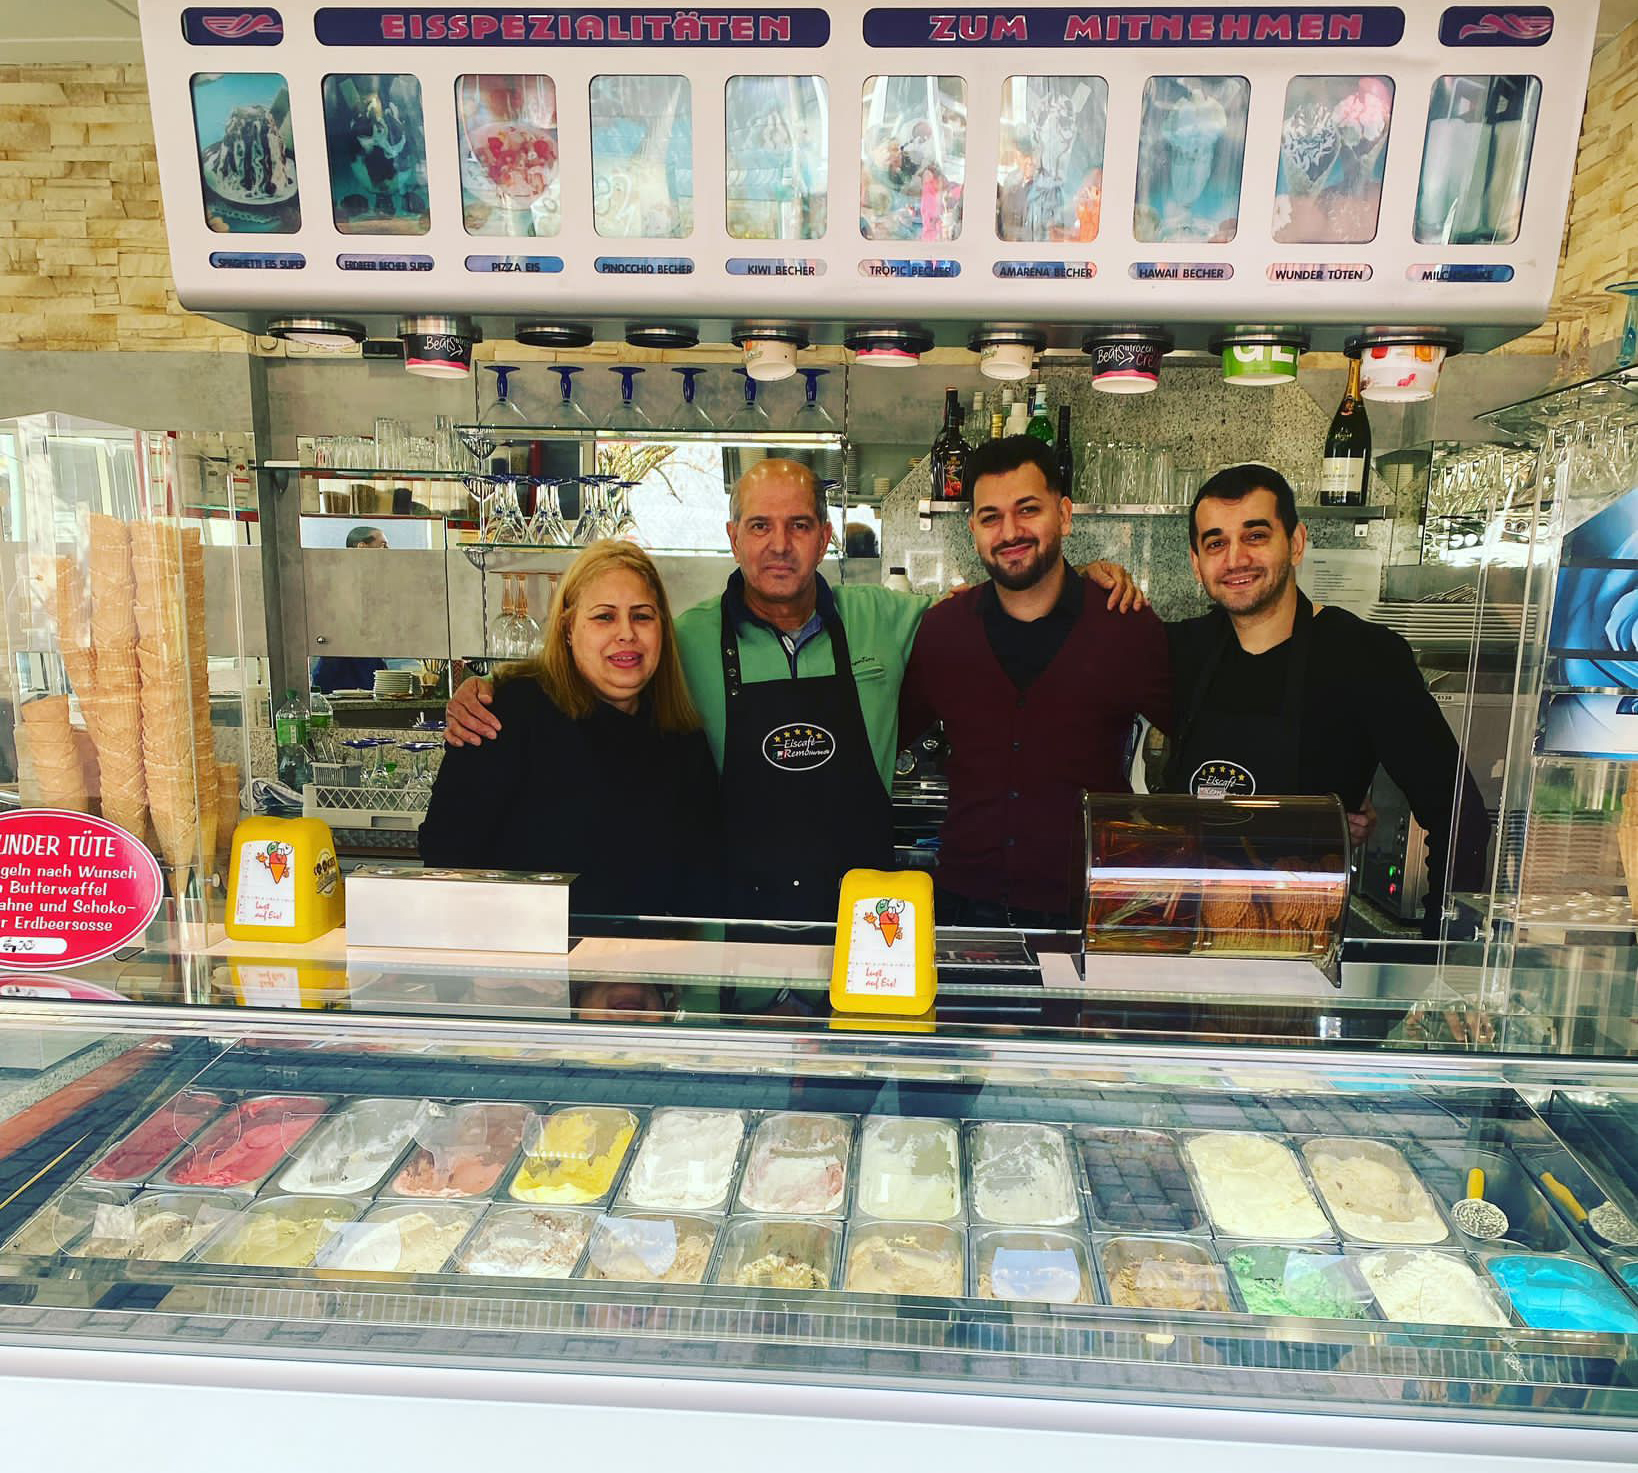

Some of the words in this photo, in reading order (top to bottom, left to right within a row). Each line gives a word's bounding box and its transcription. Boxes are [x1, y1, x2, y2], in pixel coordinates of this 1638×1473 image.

[381, 11, 791, 41] EISSPEZIALITÄTEN
[929, 14, 1029, 41] ZUM
[1063, 14, 1364, 41] MITNEHMEN
[491, 262, 521, 272] PIZZA
[525, 262, 541, 273] EIS
[602, 263, 654, 274] PINOCCHIO
[657, 264, 693, 275] BECHER
[747, 265, 771, 275] KIWI
[775, 266, 815, 276] BECHER
[869, 265, 906, 276] TROPIC
[999, 266, 1050, 277] AMARENA
[1054, 267, 1093, 278] BECHER
[1138, 267, 1178, 278] HAWAII
[1182, 268, 1224, 279] BECHER
[1275, 269, 1324, 280] WUNDER
[1327, 268, 1363, 281] TÜTEN
[68, 830, 118, 858] TÜTE
[0, 862, 31, 879] geln
[37, 863, 73, 878] nach
[78, 864, 138, 880] Wunsch
[9, 880, 108, 896] Butterwaffel
[40, 899, 67, 913] und
[72, 898, 137, 915] Schoko-
[14, 916, 113, 932] Erdbeersosse
[865, 966, 883, 977] Lust
[865, 977, 880, 991] auf
[881, 976, 897, 988] Eis!
